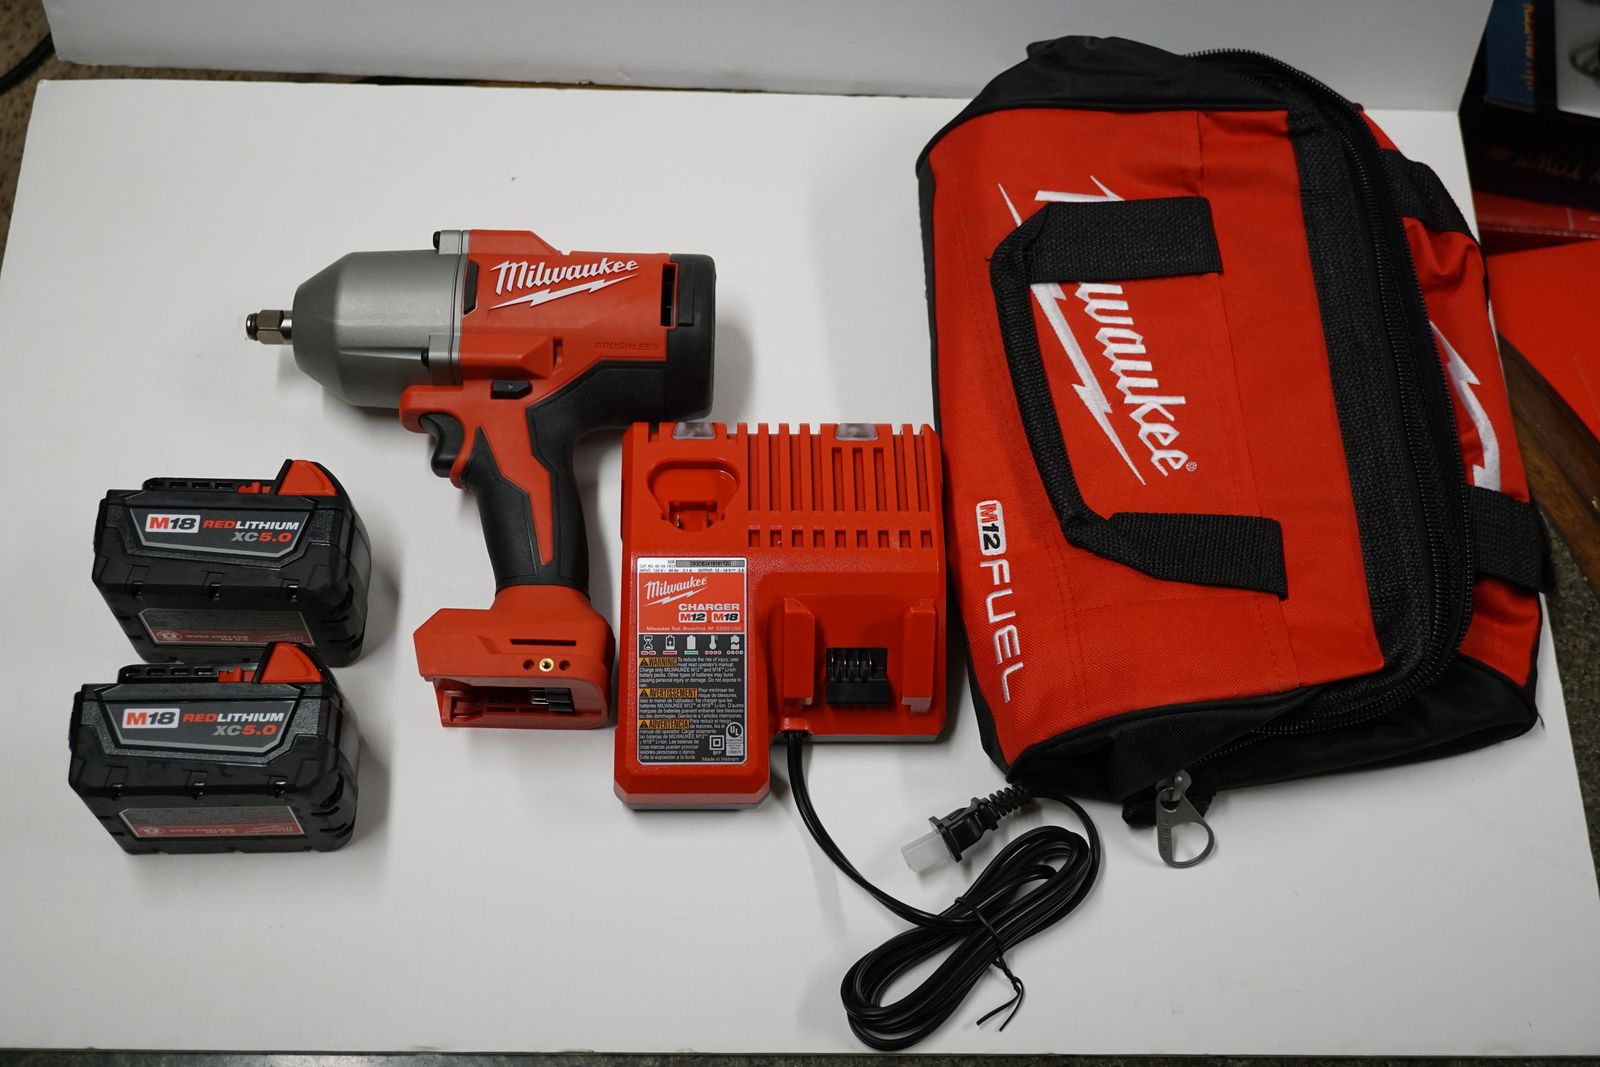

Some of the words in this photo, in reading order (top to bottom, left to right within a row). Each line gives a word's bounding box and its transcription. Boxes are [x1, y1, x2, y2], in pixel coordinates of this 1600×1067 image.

[489, 257, 640, 296] Milwaukee
[595, 341, 660, 351] BRUSHLESS
[149, 517, 197, 530] M18
[202, 519, 300, 531] REDLITHIUM
[979, 502, 1001, 551] M12
[231, 531, 293, 542] XC5.0
[643, 576, 708, 599] Milwaukee
[678, 603, 740, 611] CHARGER
[680, 613, 707, 621] M12
[713, 613, 739, 621] M18
[979, 558, 1024, 704] FUEL
[649, 657, 677, 667] WARNING
[650, 688, 697, 697] AVERTISSEMENT
[125, 711, 177, 726] M18
[183, 712, 285, 723] REDLITHIUM
[212, 724, 277, 736] XC5.0
[649, 720, 689, 729] ADVERTENCIA
